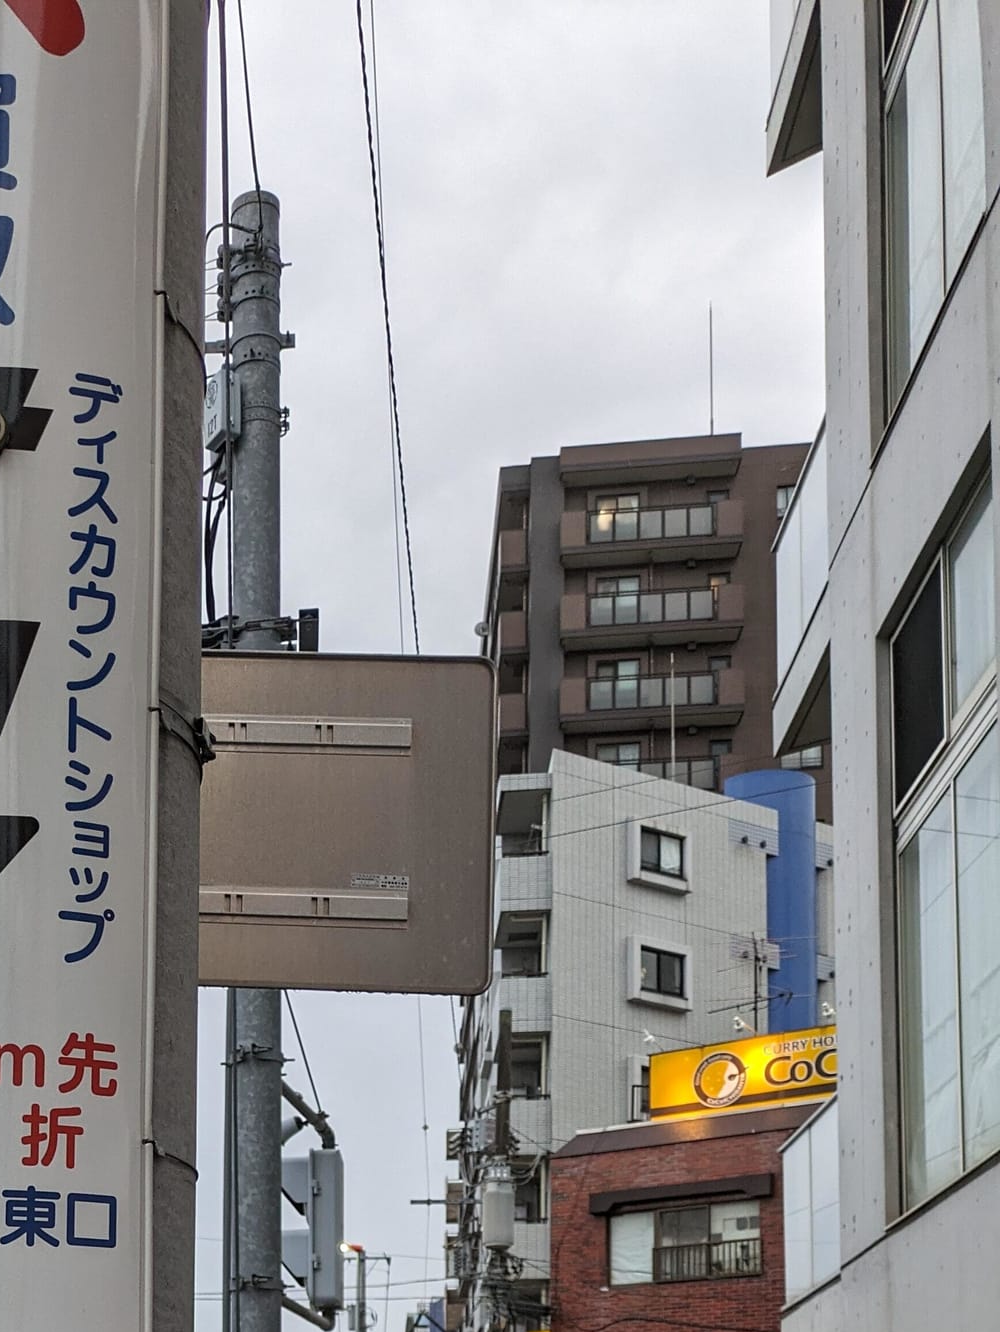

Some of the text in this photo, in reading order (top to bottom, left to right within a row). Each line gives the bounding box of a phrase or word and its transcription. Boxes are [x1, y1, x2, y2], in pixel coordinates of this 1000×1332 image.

[58, 373, 123, 963] ディスカウントショップ
[764, 1035, 837, 1056] CURRY HO
